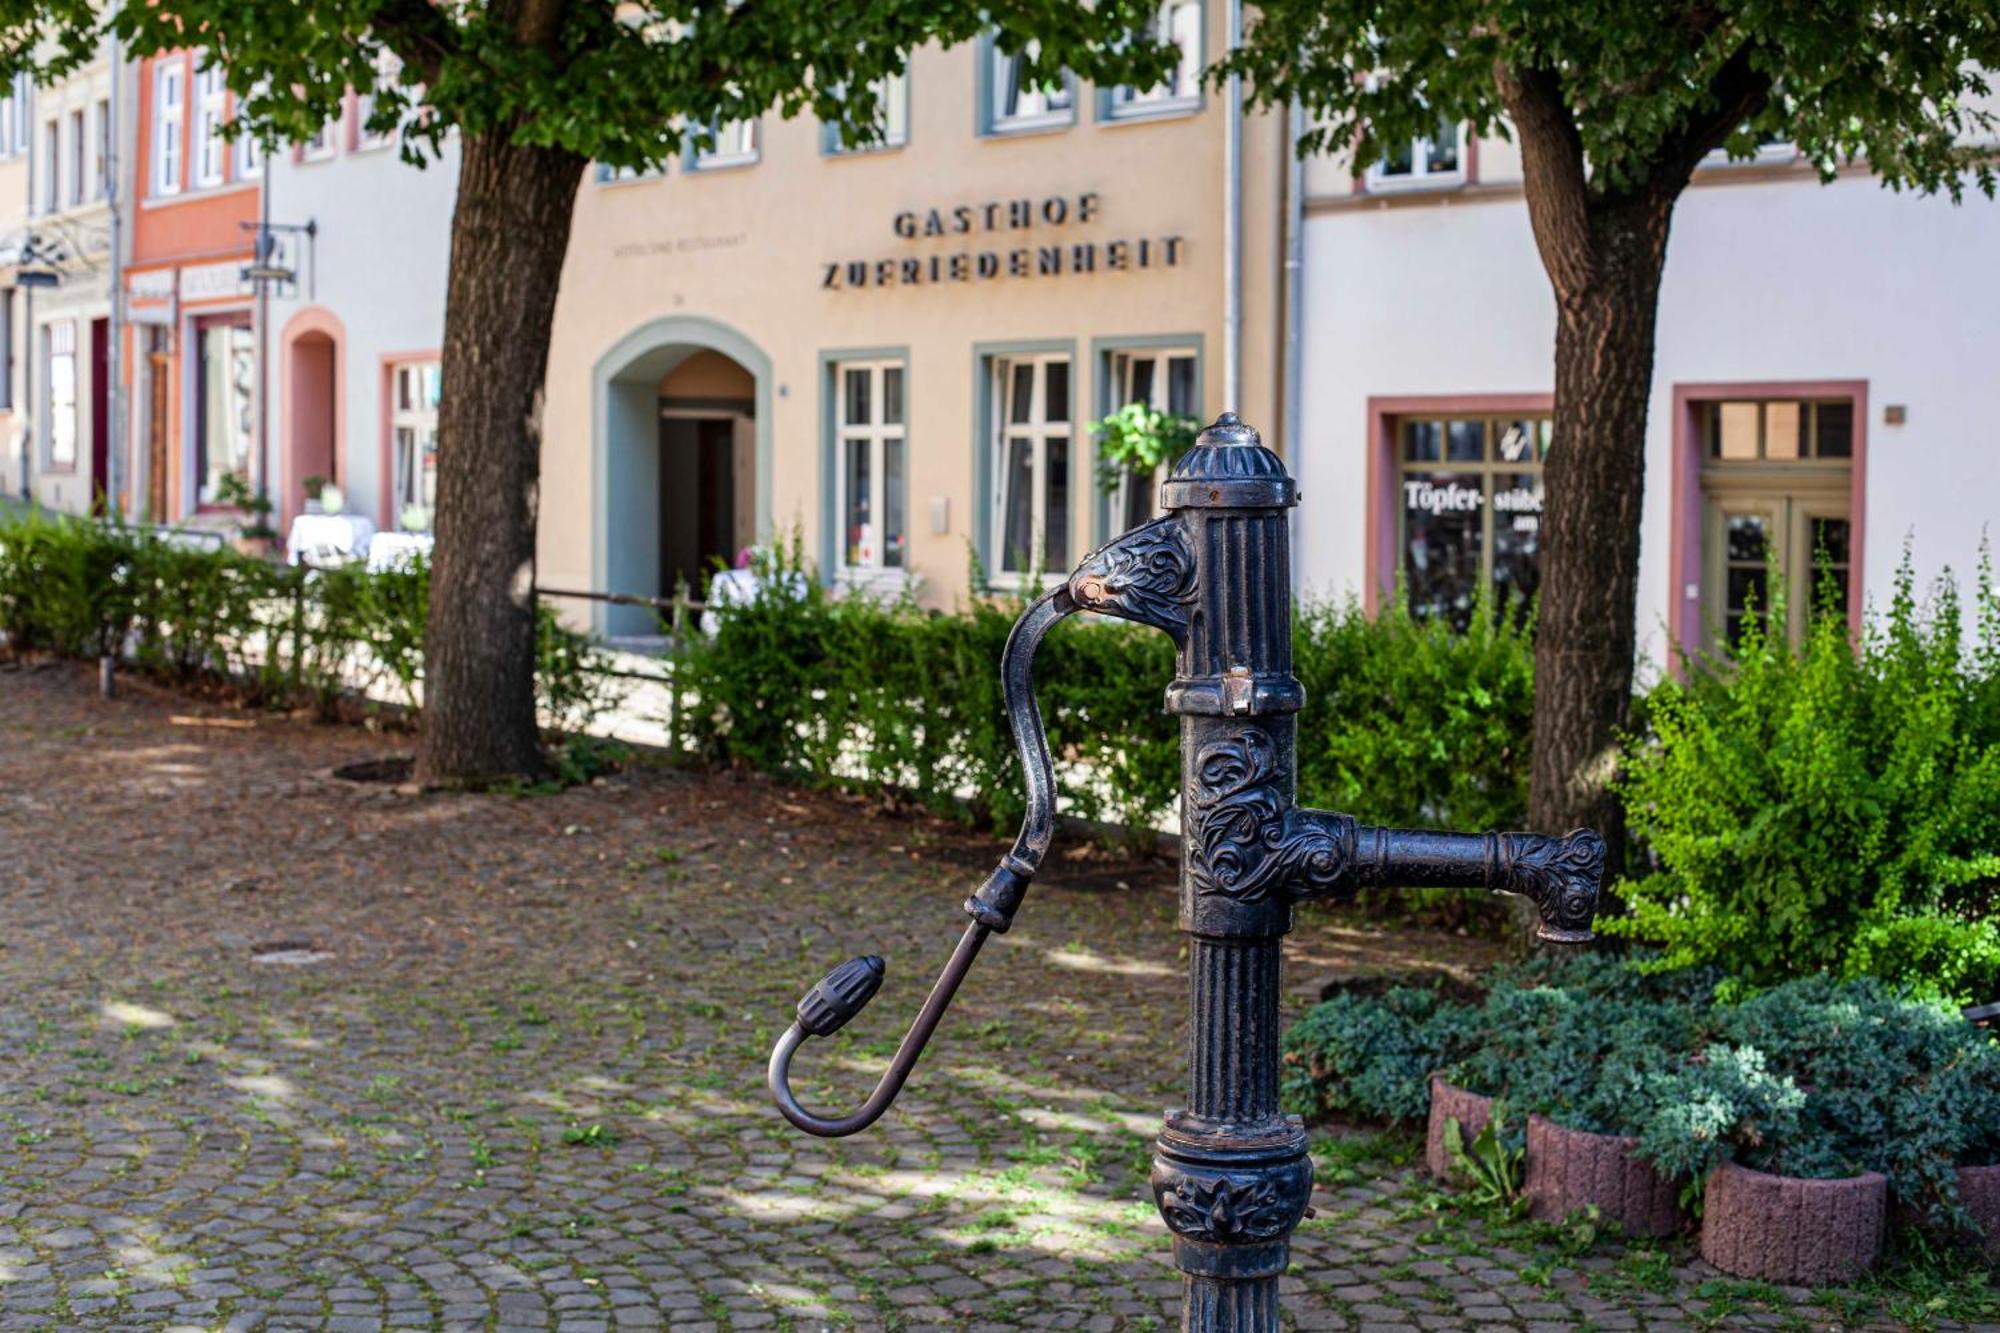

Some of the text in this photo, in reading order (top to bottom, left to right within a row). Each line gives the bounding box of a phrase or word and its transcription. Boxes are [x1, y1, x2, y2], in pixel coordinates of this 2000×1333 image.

[893, 193, 1100, 239] GASTHOF
[822, 236, 1186, 290] ZUFRIEDENHEIT
[1404, 481, 1485, 514] Töpfer-
